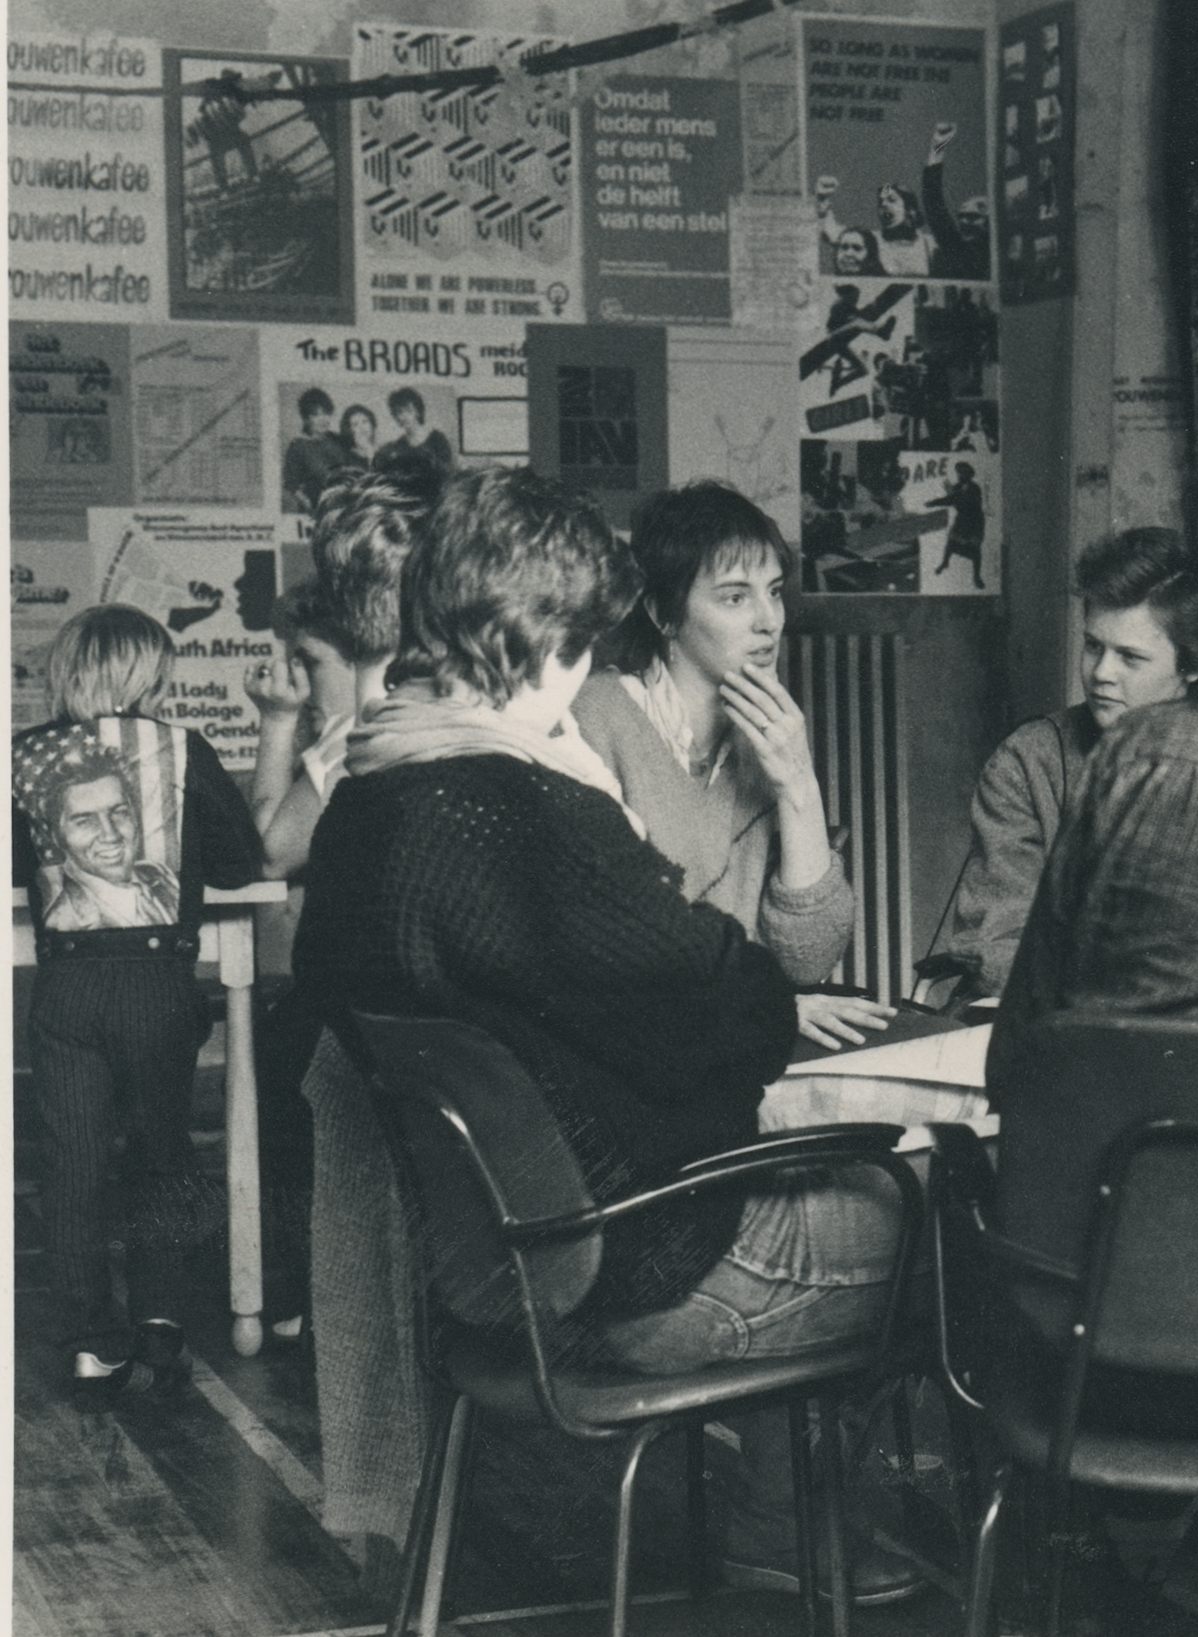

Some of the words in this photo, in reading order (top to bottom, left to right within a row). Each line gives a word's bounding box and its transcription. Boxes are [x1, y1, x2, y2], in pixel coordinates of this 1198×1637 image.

[594, 87, 670, 111] Omdat
[595, 110, 651, 133] ieder
[656, 118, 716, 137] mens
[596, 139, 619, 157] er
[621, 140, 664, 158] een
[667, 137, 692, 164] is,
[8, 152, 149, 192] ouwenkafee
[596, 163, 624, 181] en
[629, 161, 671, 182] niet
[597, 184, 626, 205] de
[631, 184, 681, 207] helft
[598, 212, 639, 229] van
[642, 213, 685, 231] een
[297, 338, 340, 362] The
[344, 338, 472, 378] BROADS
[173, 639, 208, 658] uth
[211, 637, 272, 658] Africa
[180, 681, 228, 700] Lady
